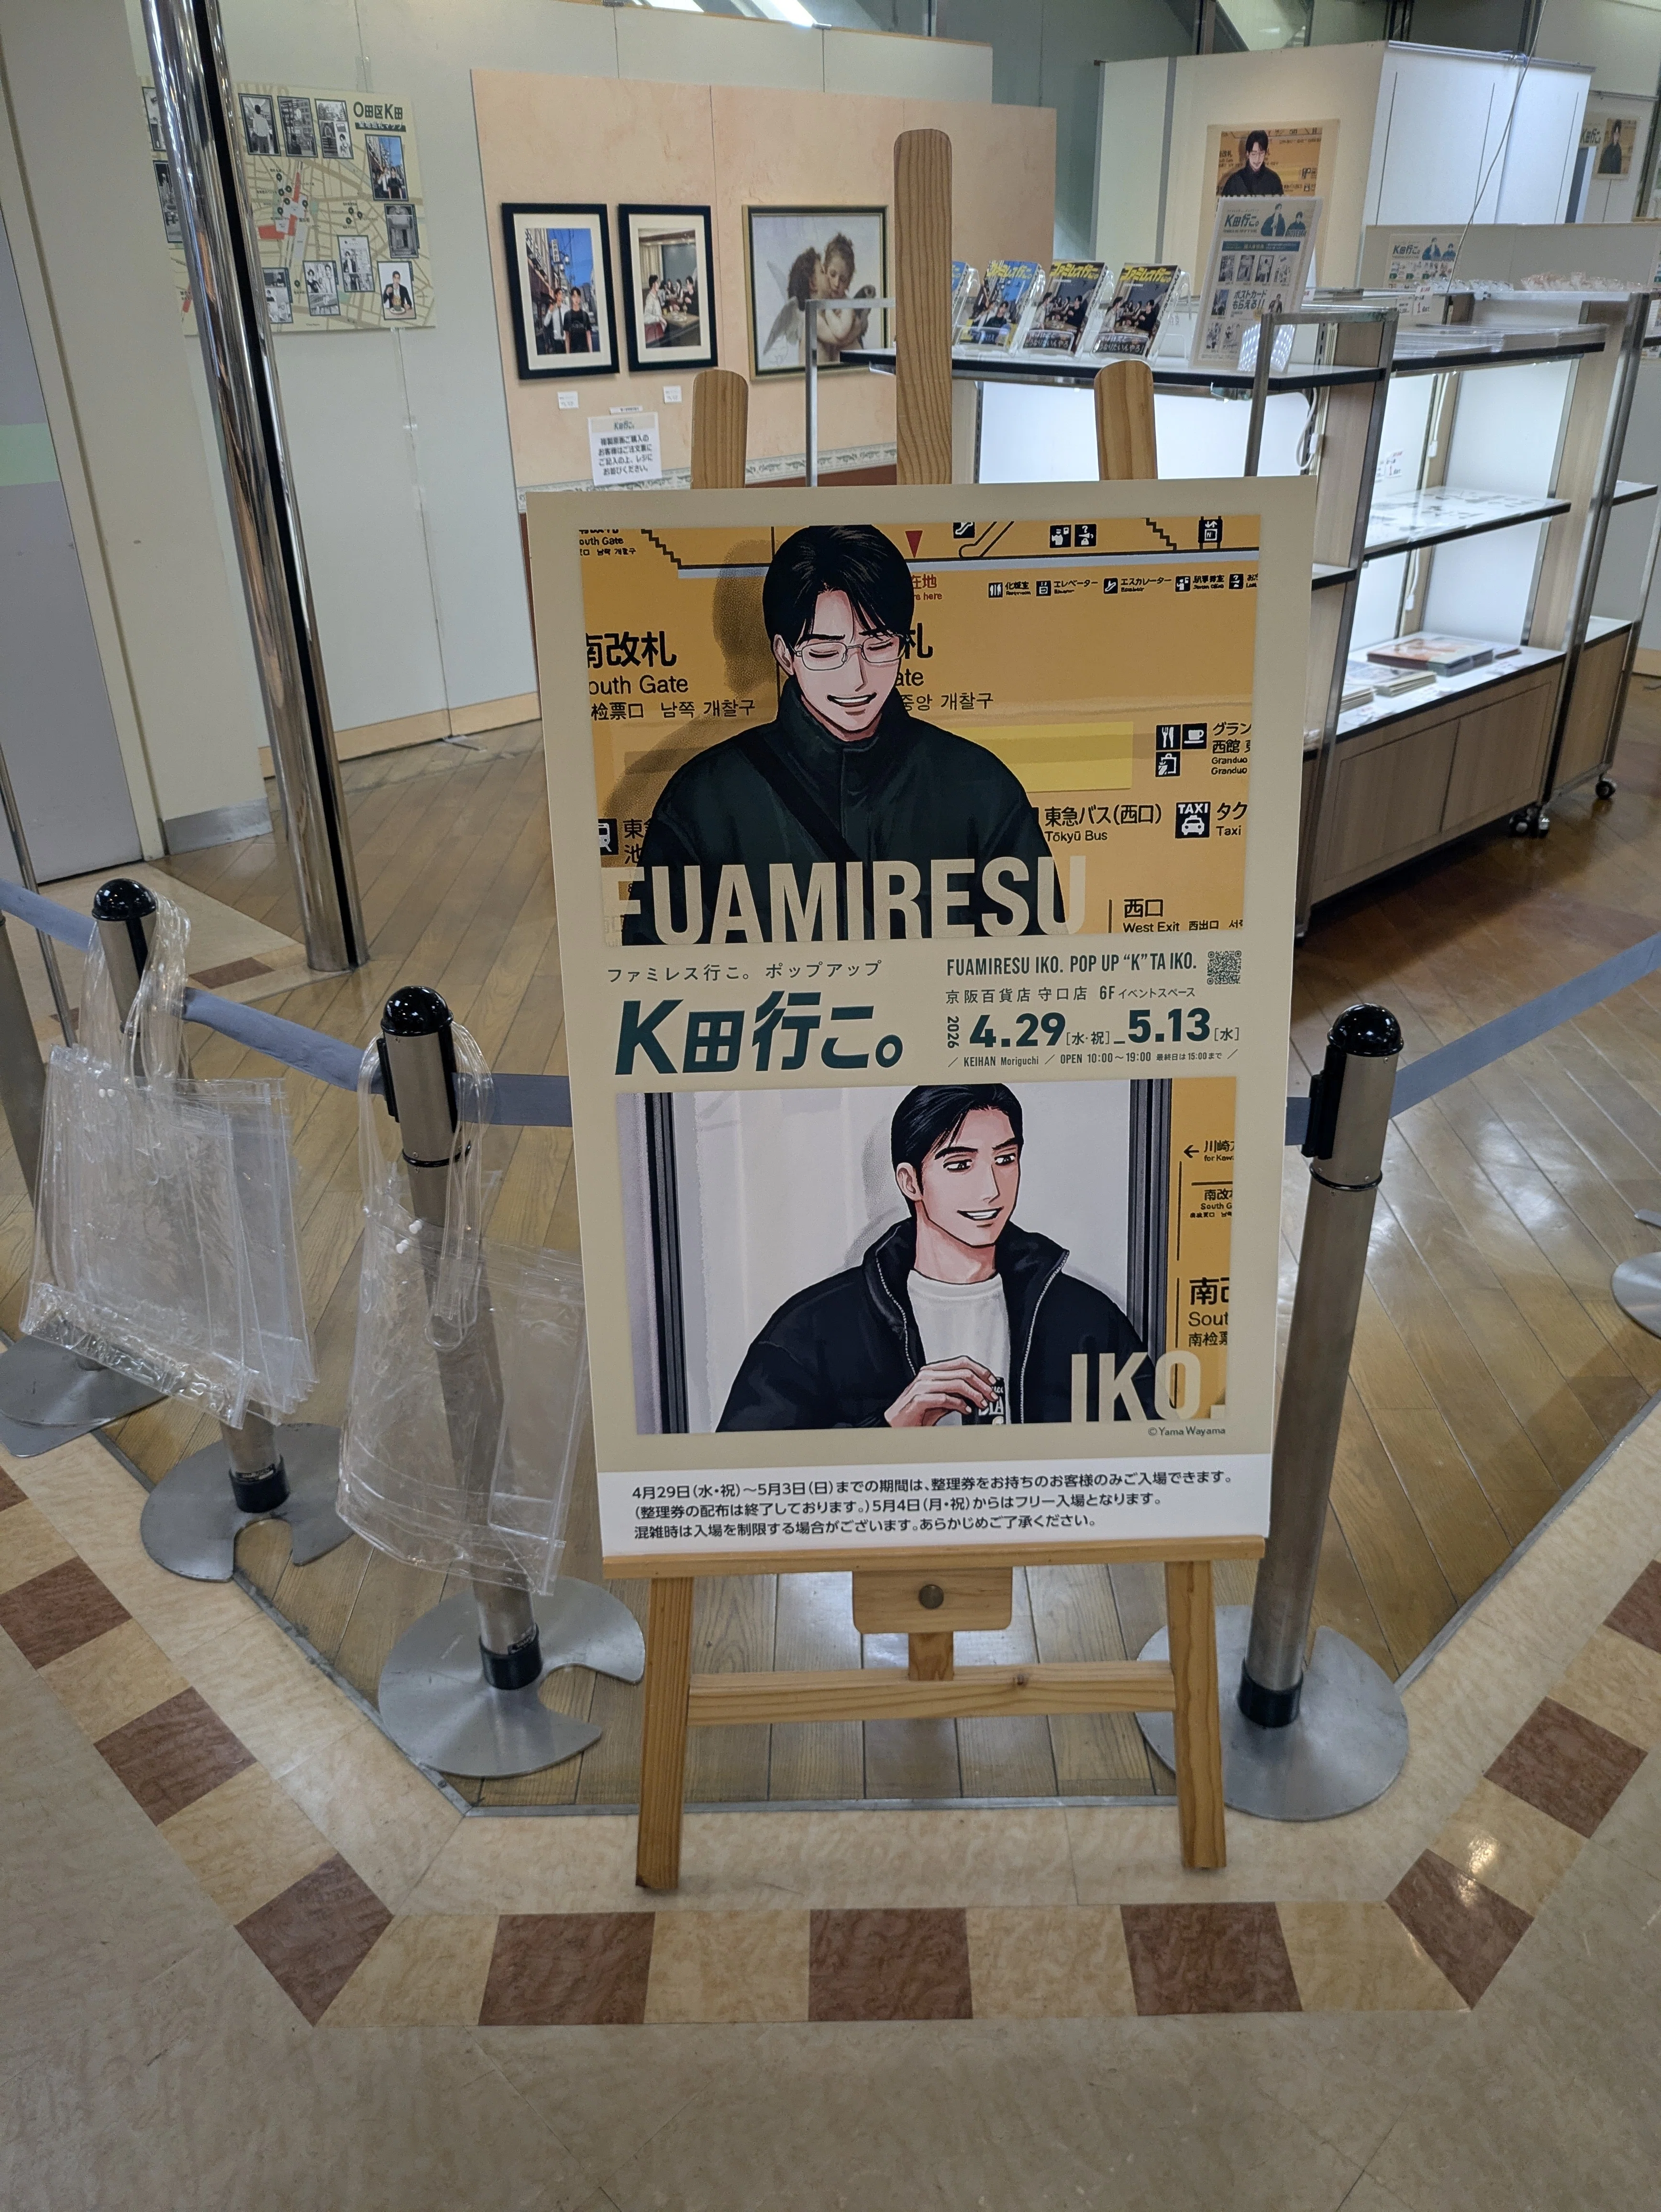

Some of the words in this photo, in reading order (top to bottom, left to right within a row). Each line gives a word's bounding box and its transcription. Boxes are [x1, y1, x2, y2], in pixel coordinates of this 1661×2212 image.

[354, 101, 403, 120] O田区K田
[1224, 213, 1260, 227] K田行こ。
[1233, 289, 1267, 299] ポストカード
[601, 536, 624, 545] Gate
[1053, 579, 1099, 588] エレベーター
[1120, 576, 1172, 586] エスカレーター
[923, 592, 942, 601] here
[640, 675, 689, 694] Gate
[941, 692, 994, 710] 개찰구
[661, 701, 695, 719] 남쪽
[703, 699, 755, 718] 개찰구
[1212, 721, 1251, 736] グラン
[1212, 739, 1240, 754] 西館
[1211, 756, 1248, 764] Granduo
[1211, 766, 1248, 775] Granduo
[1044, 803, 1162, 828] 東急バス(西口)
[1178, 803, 1209, 814] TAXI
[1044, 830, 1081, 844] Tōkyū
[1085, 830, 1108, 841] Bus
[1216, 825, 1242, 837] Taxi
[601, 855, 1086, 946] FUAMIRESU
[1124, 898, 1163, 918] 西口
[1123, 922, 1154, 933] West
[1157, 921, 1180, 932] Exit
[1189, 919, 1219, 931] 西出口
[608, 963, 749, 983] ファミレス行こ。
[765, 959, 882, 979] ポップアップ
[947, 957, 1030, 976] FUAMIRESU
[1035, 956, 1063, 974] IKO.
[1070, 955, 1096, 973] POP
[1101, 954, 1119, 972] UP
[1170, 952, 1197, 969] IKO.
[945, 988, 1031, 1004] 京阪百貨店
[1038, 986, 1088, 1002] 守口店
[614, 990, 904, 1076] K田行こ。
[947, 1016, 960, 1049] 2026
[963, 1056, 996, 1067] KEIHAN
[1001, 1056, 1039, 1066] Moriguchi
[1060, 1054, 1083, 1064] OPEN
[1204, 1188, 1233, 1201] 南改
[1072, 1350, 1226, 1424] IKO.
[1186, 1426, 1226, 1436] Wayama
